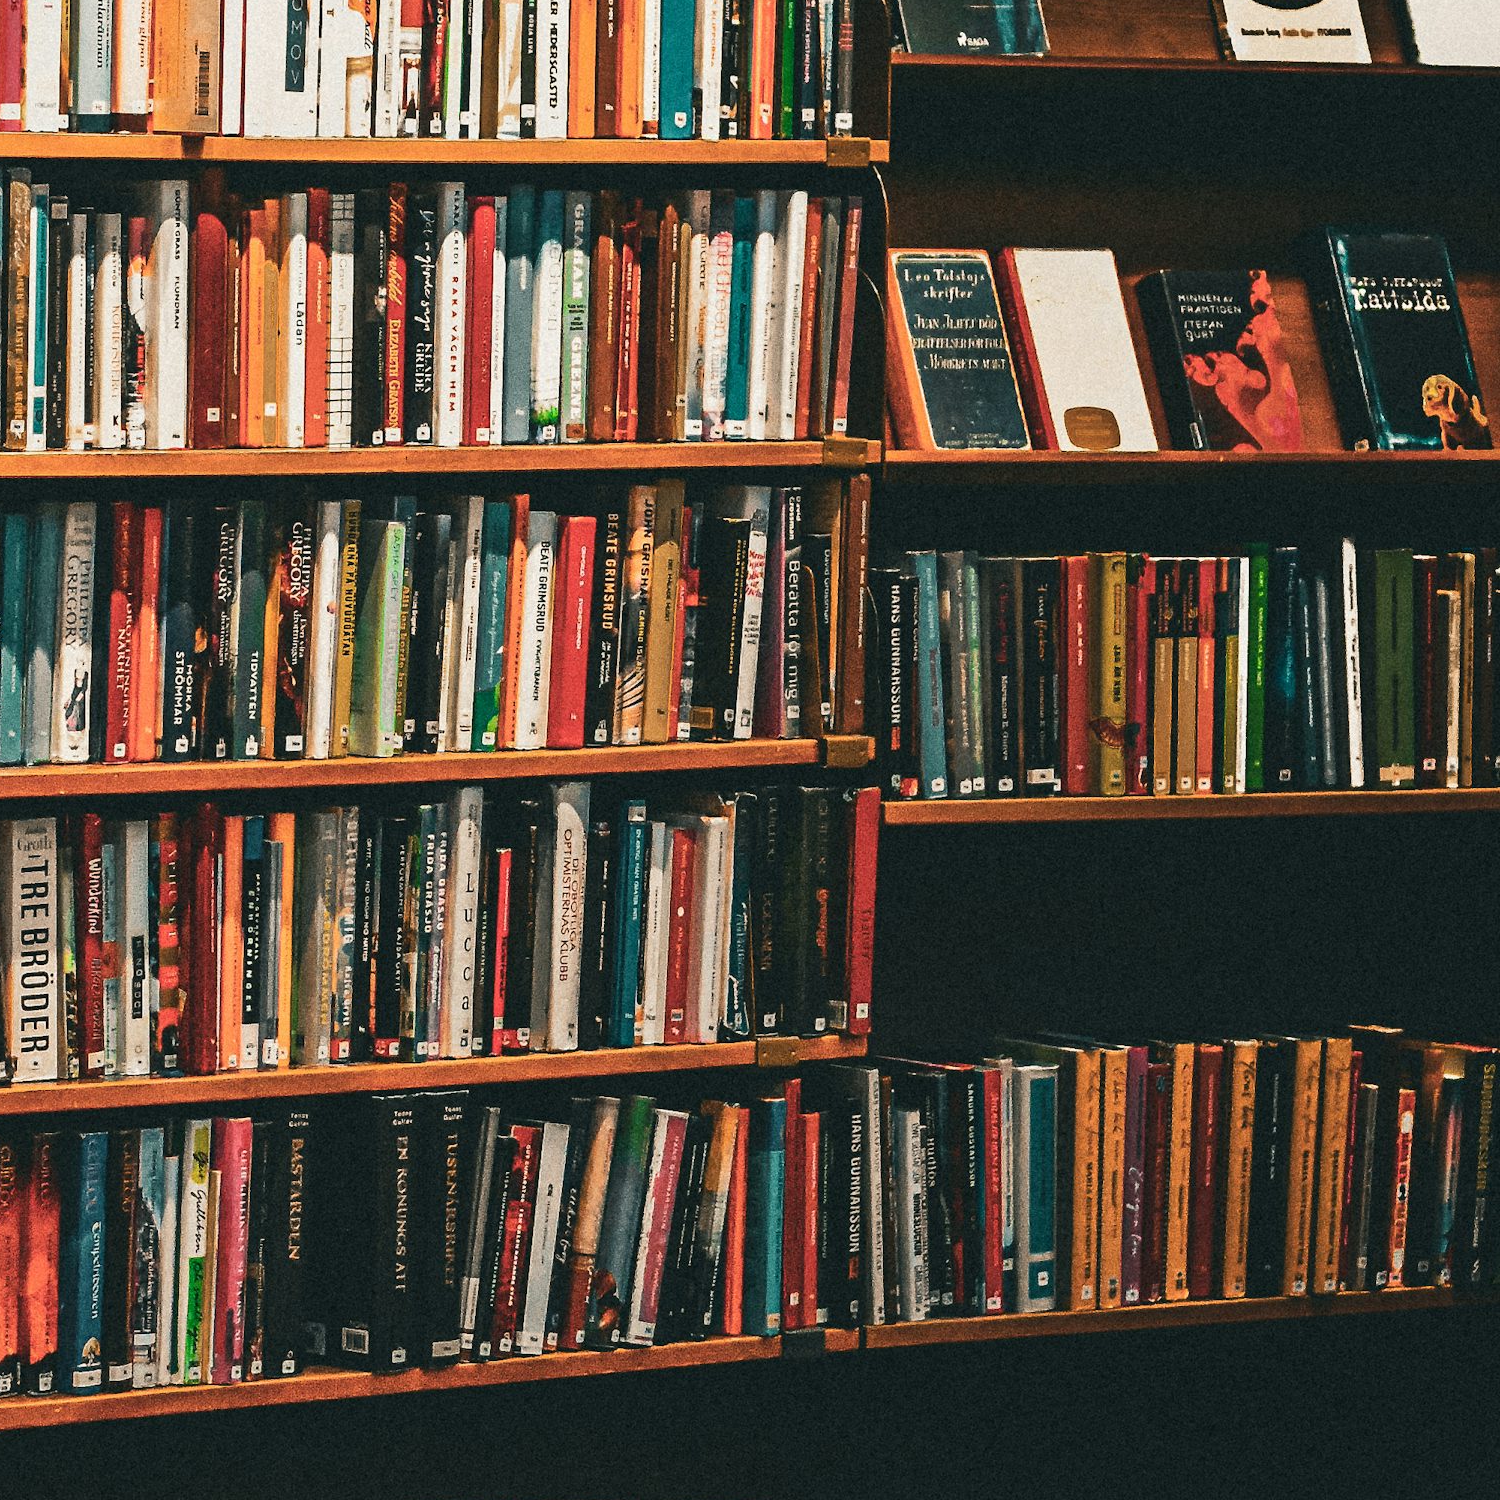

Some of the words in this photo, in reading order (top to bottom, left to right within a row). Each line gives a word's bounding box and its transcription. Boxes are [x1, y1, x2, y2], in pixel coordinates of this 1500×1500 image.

[295, 301, 305, 347] Lådan
[451, 276, 459, 319] RAKA
[388, 318, 401, 378] ELIZABETH
[414, 341, 425, 394] GREDE
[449, 324, 458, 374] VÄGEN
[570, 335, 585, 421] GREENE
[606, 512, 619, 554] BEATE
[644, 498, 654, 539] JOHN
[539, 540, 551, 574] BEATE
[535, 575, 549, 634] GRIMSRUD
[602, 558, 616, 631] GRIMSRUD
[788, 560, 802, 628] Berätta
[891, 584, 900, 624] HANS
[788, 633, 800, 661] för
[891, 627, 901, 725] GUNNARSSON
[173, 650, 186, 726] STRÖMMAR
[248, 649, 260, 721] TIDVATTEN
[425, 833, 435, 875] FRIDA
[20, 857, 49, 920] TRE
[20, 927, 54, 1054] BRÖDER
[850, 1113, 862, 1155] HANS
[288, 1137, 305, 1262] BASTARDEN
[395, 1167, 408, 1257] KONUNGS
[849, 1156, 861, 1254] GUNNARSSON
